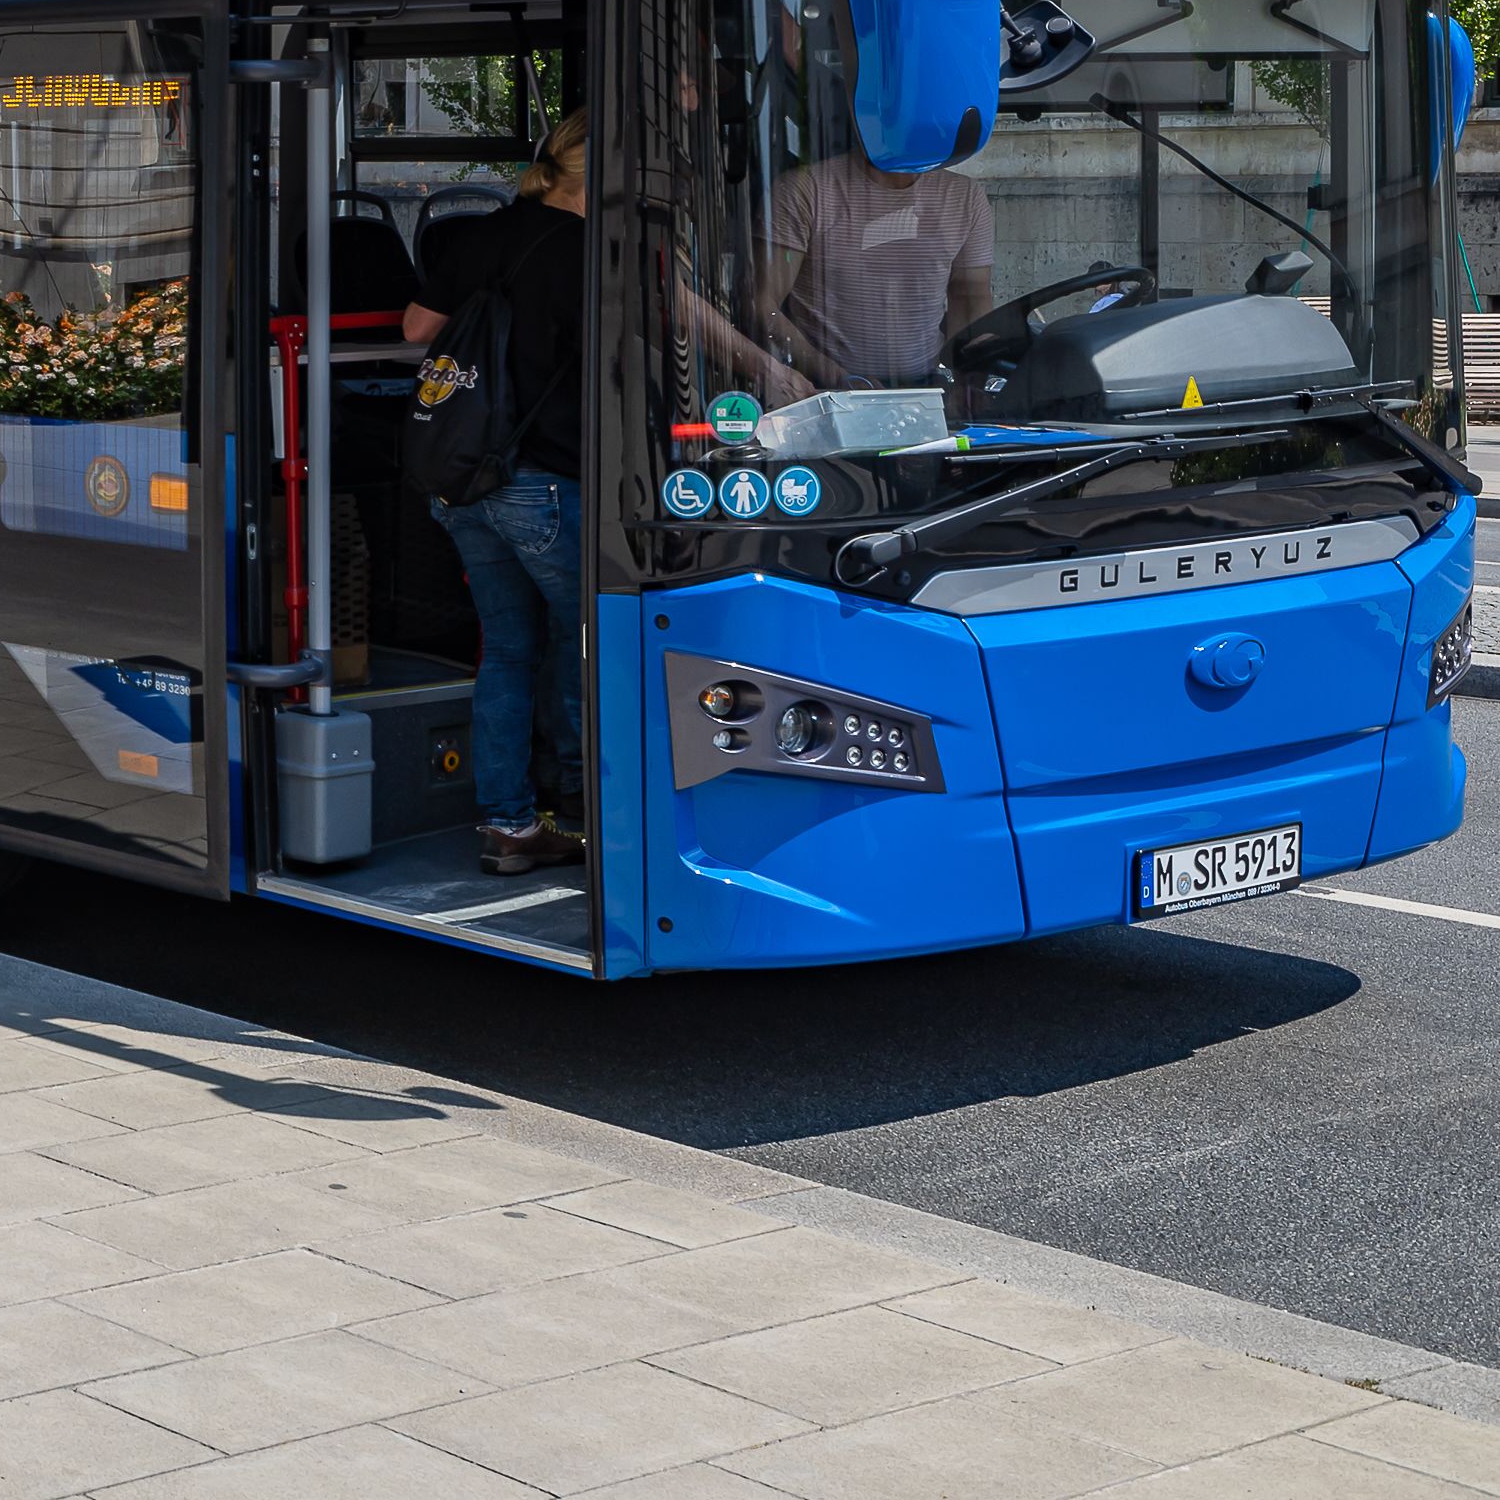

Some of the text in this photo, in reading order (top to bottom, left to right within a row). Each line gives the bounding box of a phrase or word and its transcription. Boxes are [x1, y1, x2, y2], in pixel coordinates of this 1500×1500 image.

[728, 399, 742, 418] 4
[1059, 536, 1332, 593] GULERYUZ
[1156, 831, 1296, 898] M SR 5913
[1143, 886, 1150, 898] D
[1165, 902, 1188, 913] Autobus
[1188, 896, 1221, 909] Oberbayern
[1222, 891, 1246, 902] München
